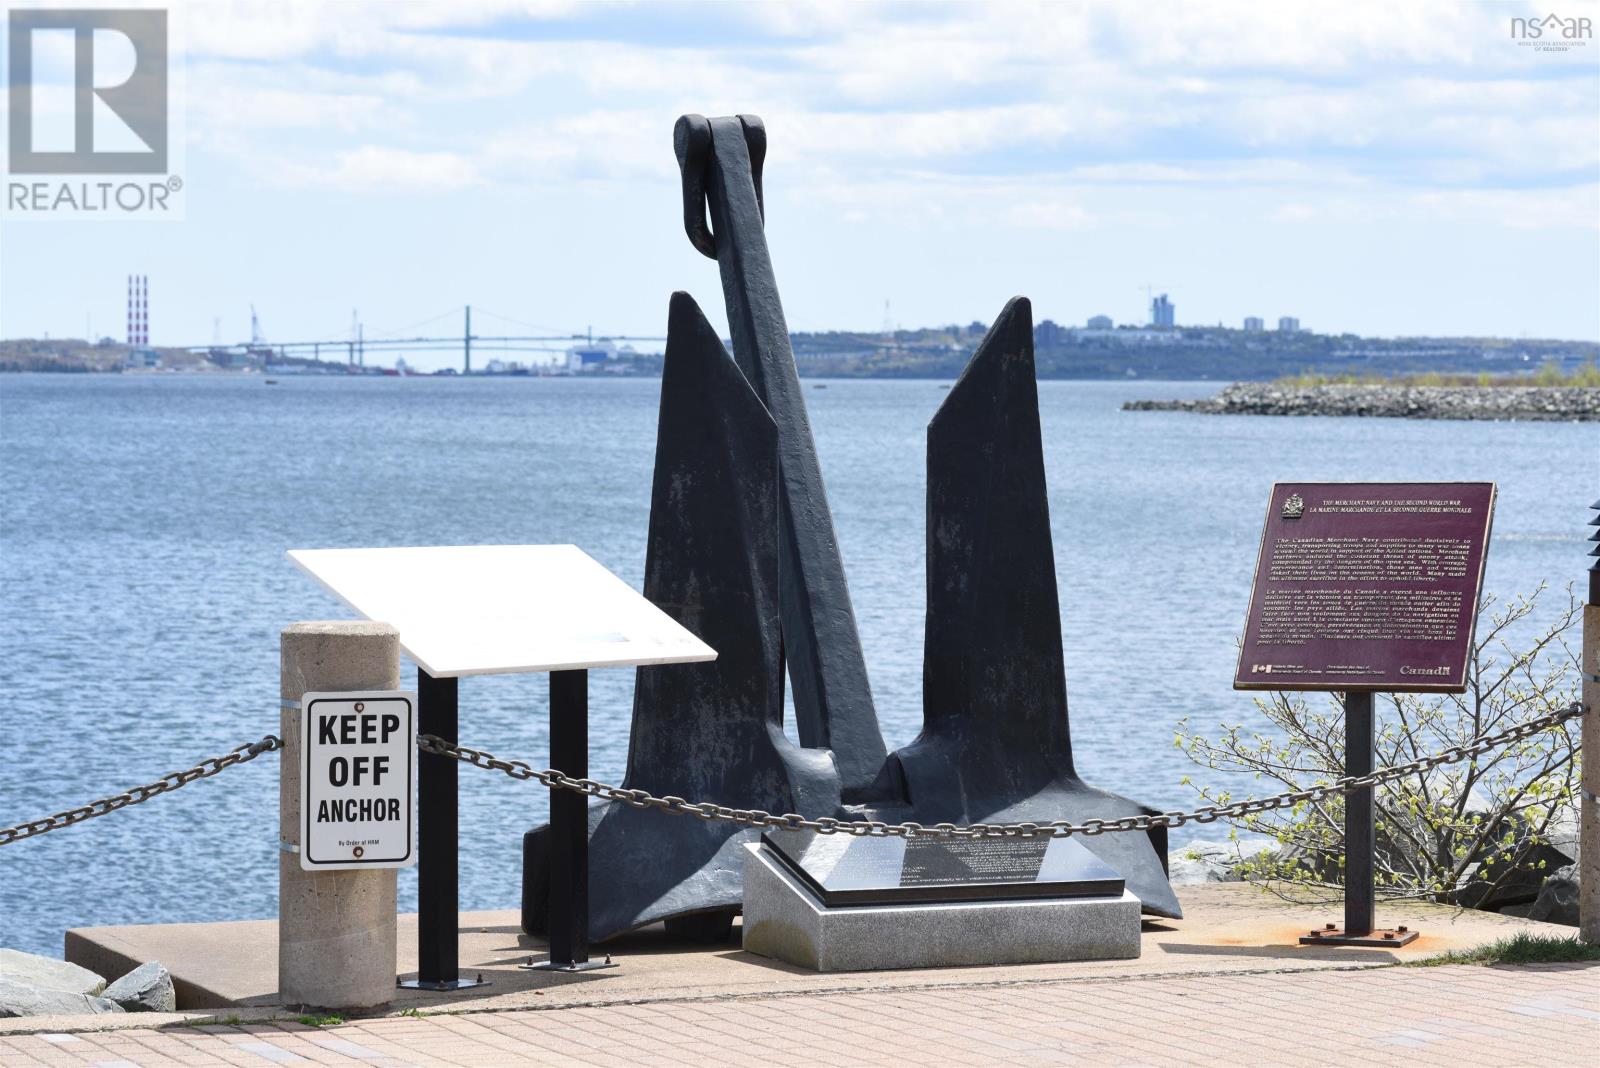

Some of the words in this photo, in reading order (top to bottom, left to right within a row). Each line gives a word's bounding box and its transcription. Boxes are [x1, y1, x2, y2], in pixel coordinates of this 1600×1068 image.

[1400, 665, 1450, 676] Canada
[318, 714, 400, 744] KEEP
[328, 756, 390, 787] OFF
[317, 798, 400, 823] ANCHOR
